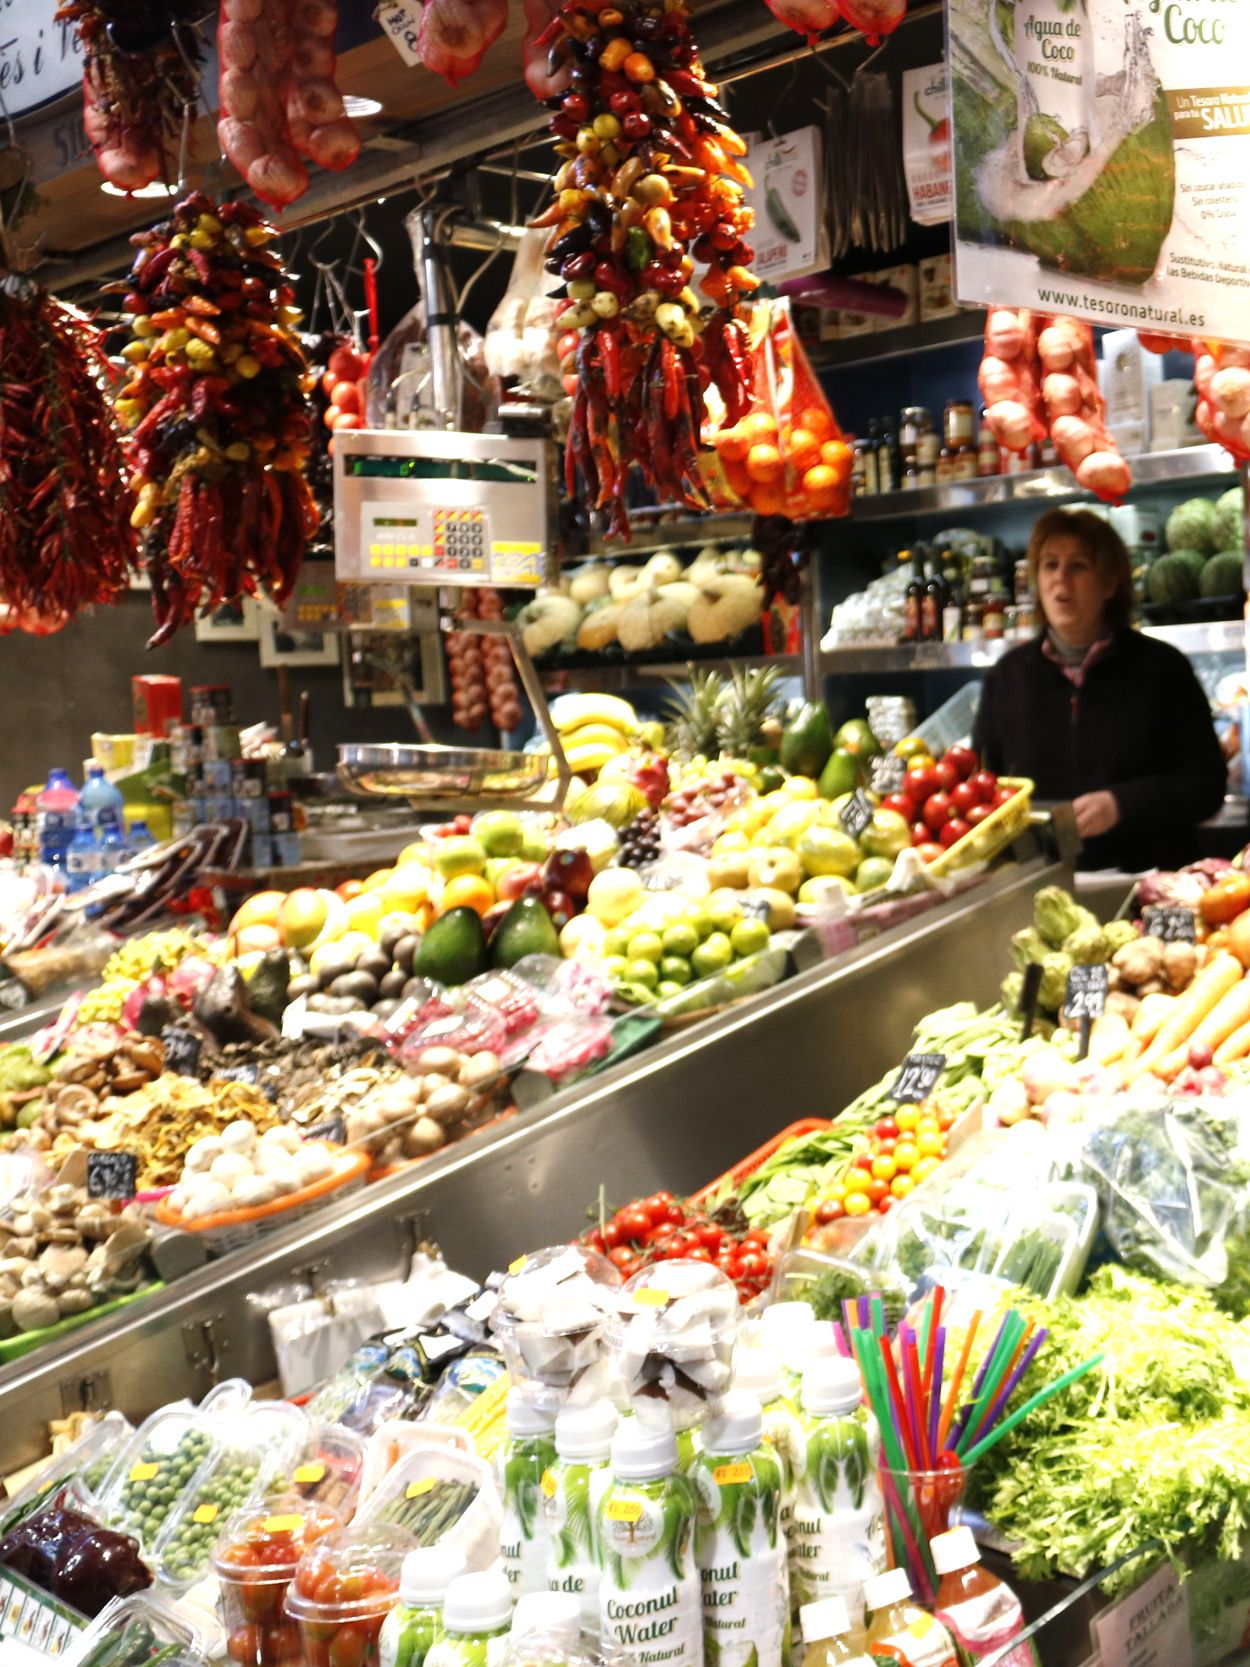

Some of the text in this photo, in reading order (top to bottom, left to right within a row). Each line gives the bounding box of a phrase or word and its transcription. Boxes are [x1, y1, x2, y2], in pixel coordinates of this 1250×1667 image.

[1023, 14, 1081, 41] Agua de
[1163, 3, 1225, 45] Coco
[33, 28, 44, 76] i
[1042, 38, 1075, 60] Coco
[1027, 61, 1083, 86] 100% Natural
[1176, 96, 1190, 109] Un
[1190, 94, 1220, 108] Tesoro
[1180, 183, 1192, 193] Sin
[1192, 197, 1204, 206] Sin
[1167, 265, 1180, 277] las
[1181, 268, 1214, 282] Bebidas
[1218, 260, 1247, 274] Natural
[1037, 288, 1206, 327] www.tesoronatural.es
[562, 1574, 584, 1593] de
[607, 1586, 678, 1620] Coconut
[614, 1616, 678, 1645] Water
[638, 1642, 685, 1664] Natural
